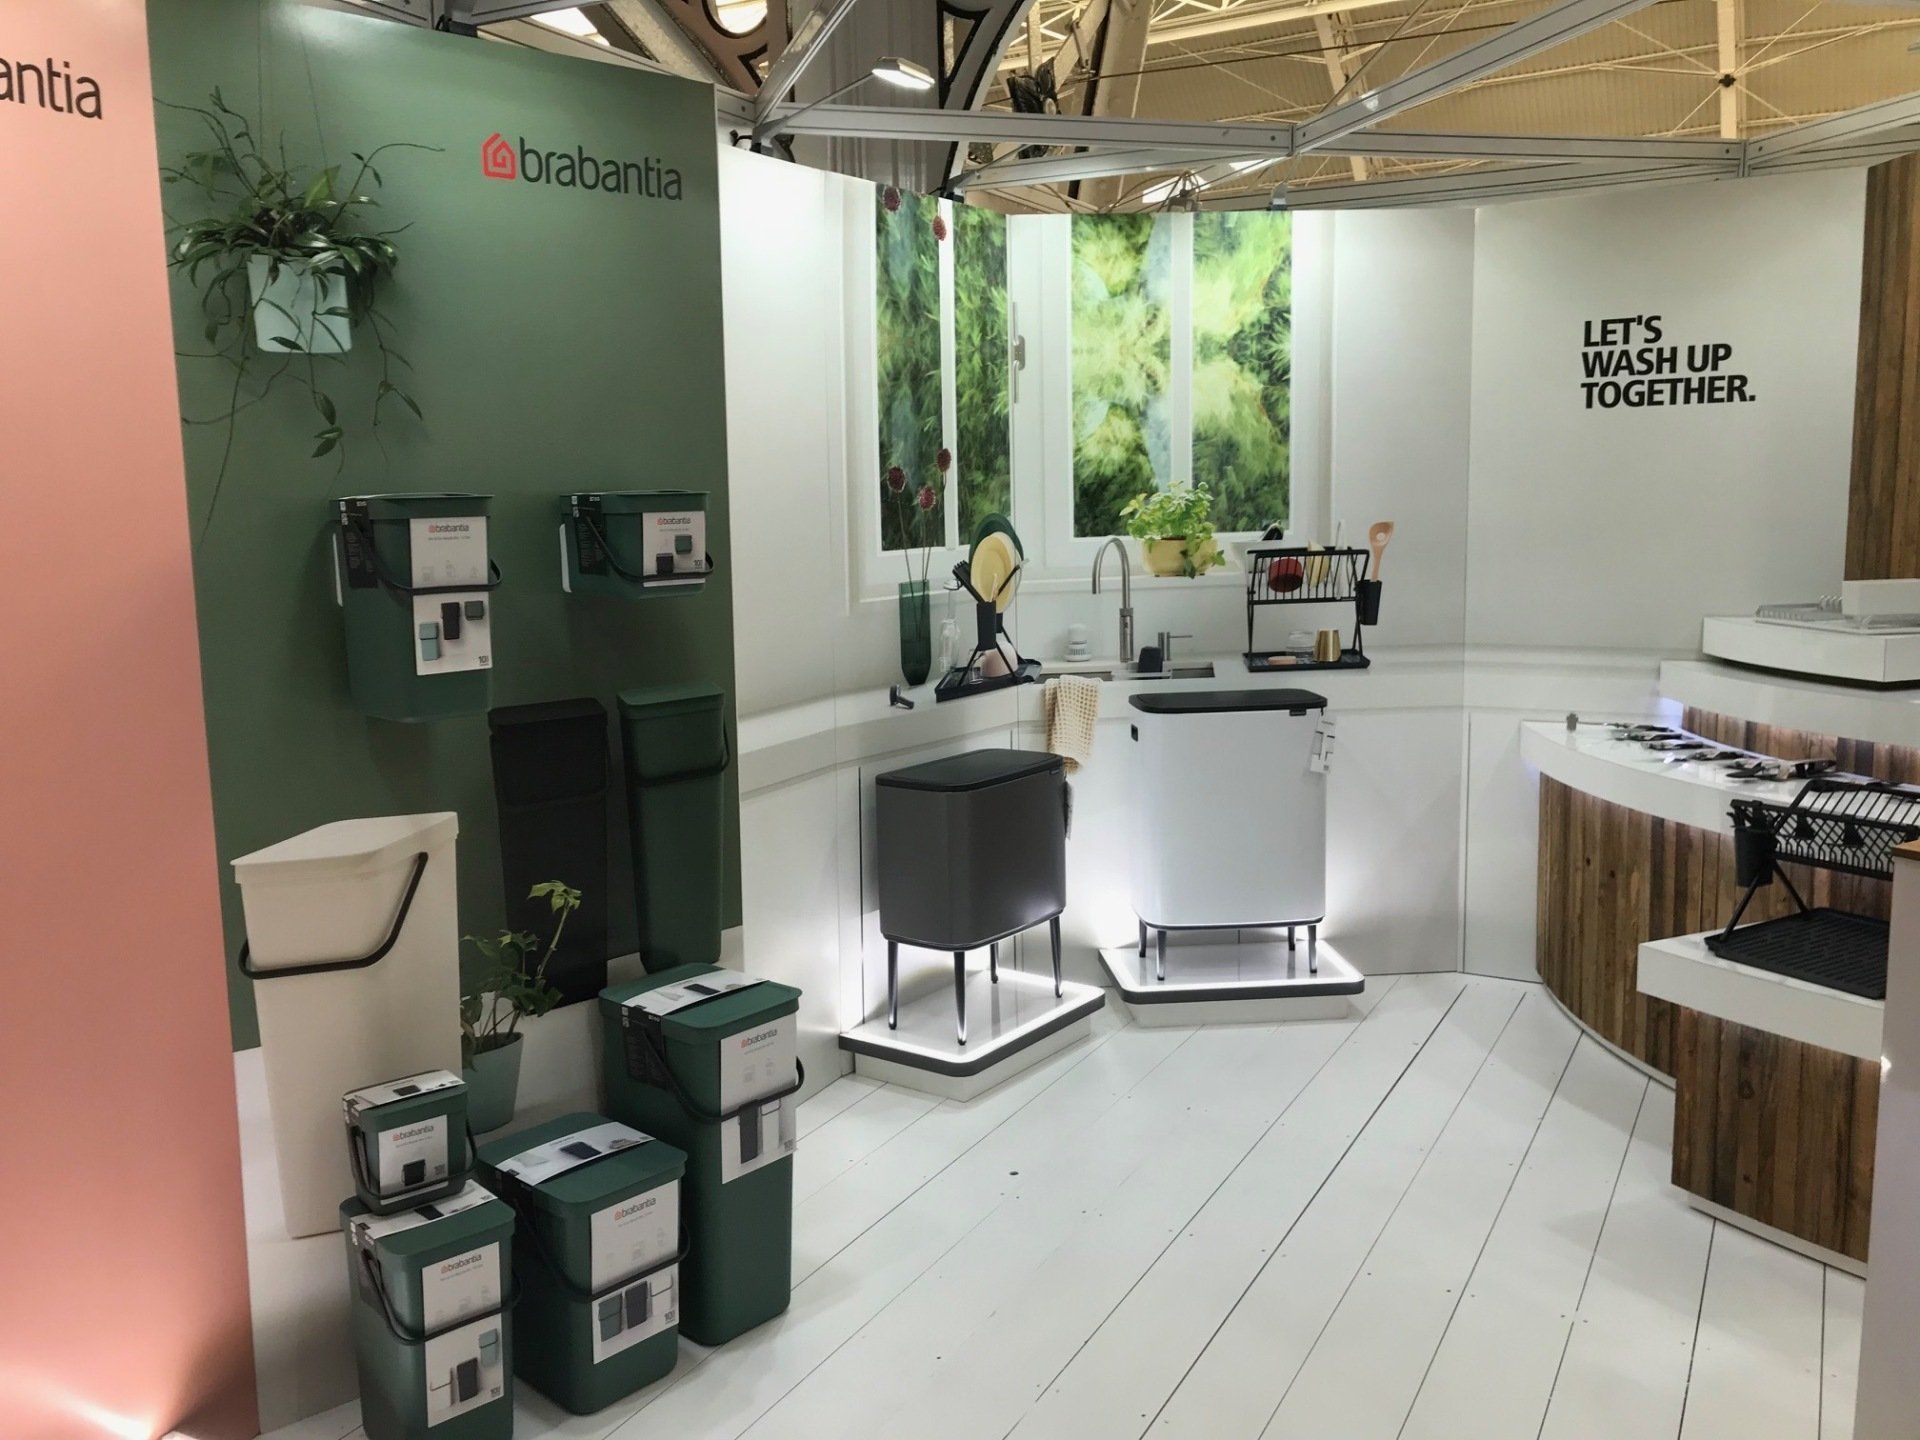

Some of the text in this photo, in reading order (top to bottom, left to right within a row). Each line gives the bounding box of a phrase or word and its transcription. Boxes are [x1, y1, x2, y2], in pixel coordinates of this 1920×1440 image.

[519, 135, 684, 201] brabantia
[1583, 314, 1663, 347] LET'S
[1581, 343, 1733, 378] WASH UP
[1580, 374, 1756, 409] TOGETHER.
[435, 524, 470, 533] brabantia
[663, 517, 692, 525] brabantia
[747, 1029, 778, 1046] brabantia
[400, 1125, 434, 1140] brabantia
[621, 1197, 657, 1218] brabantia
[448, 1254, 482, 1272] brabantia
